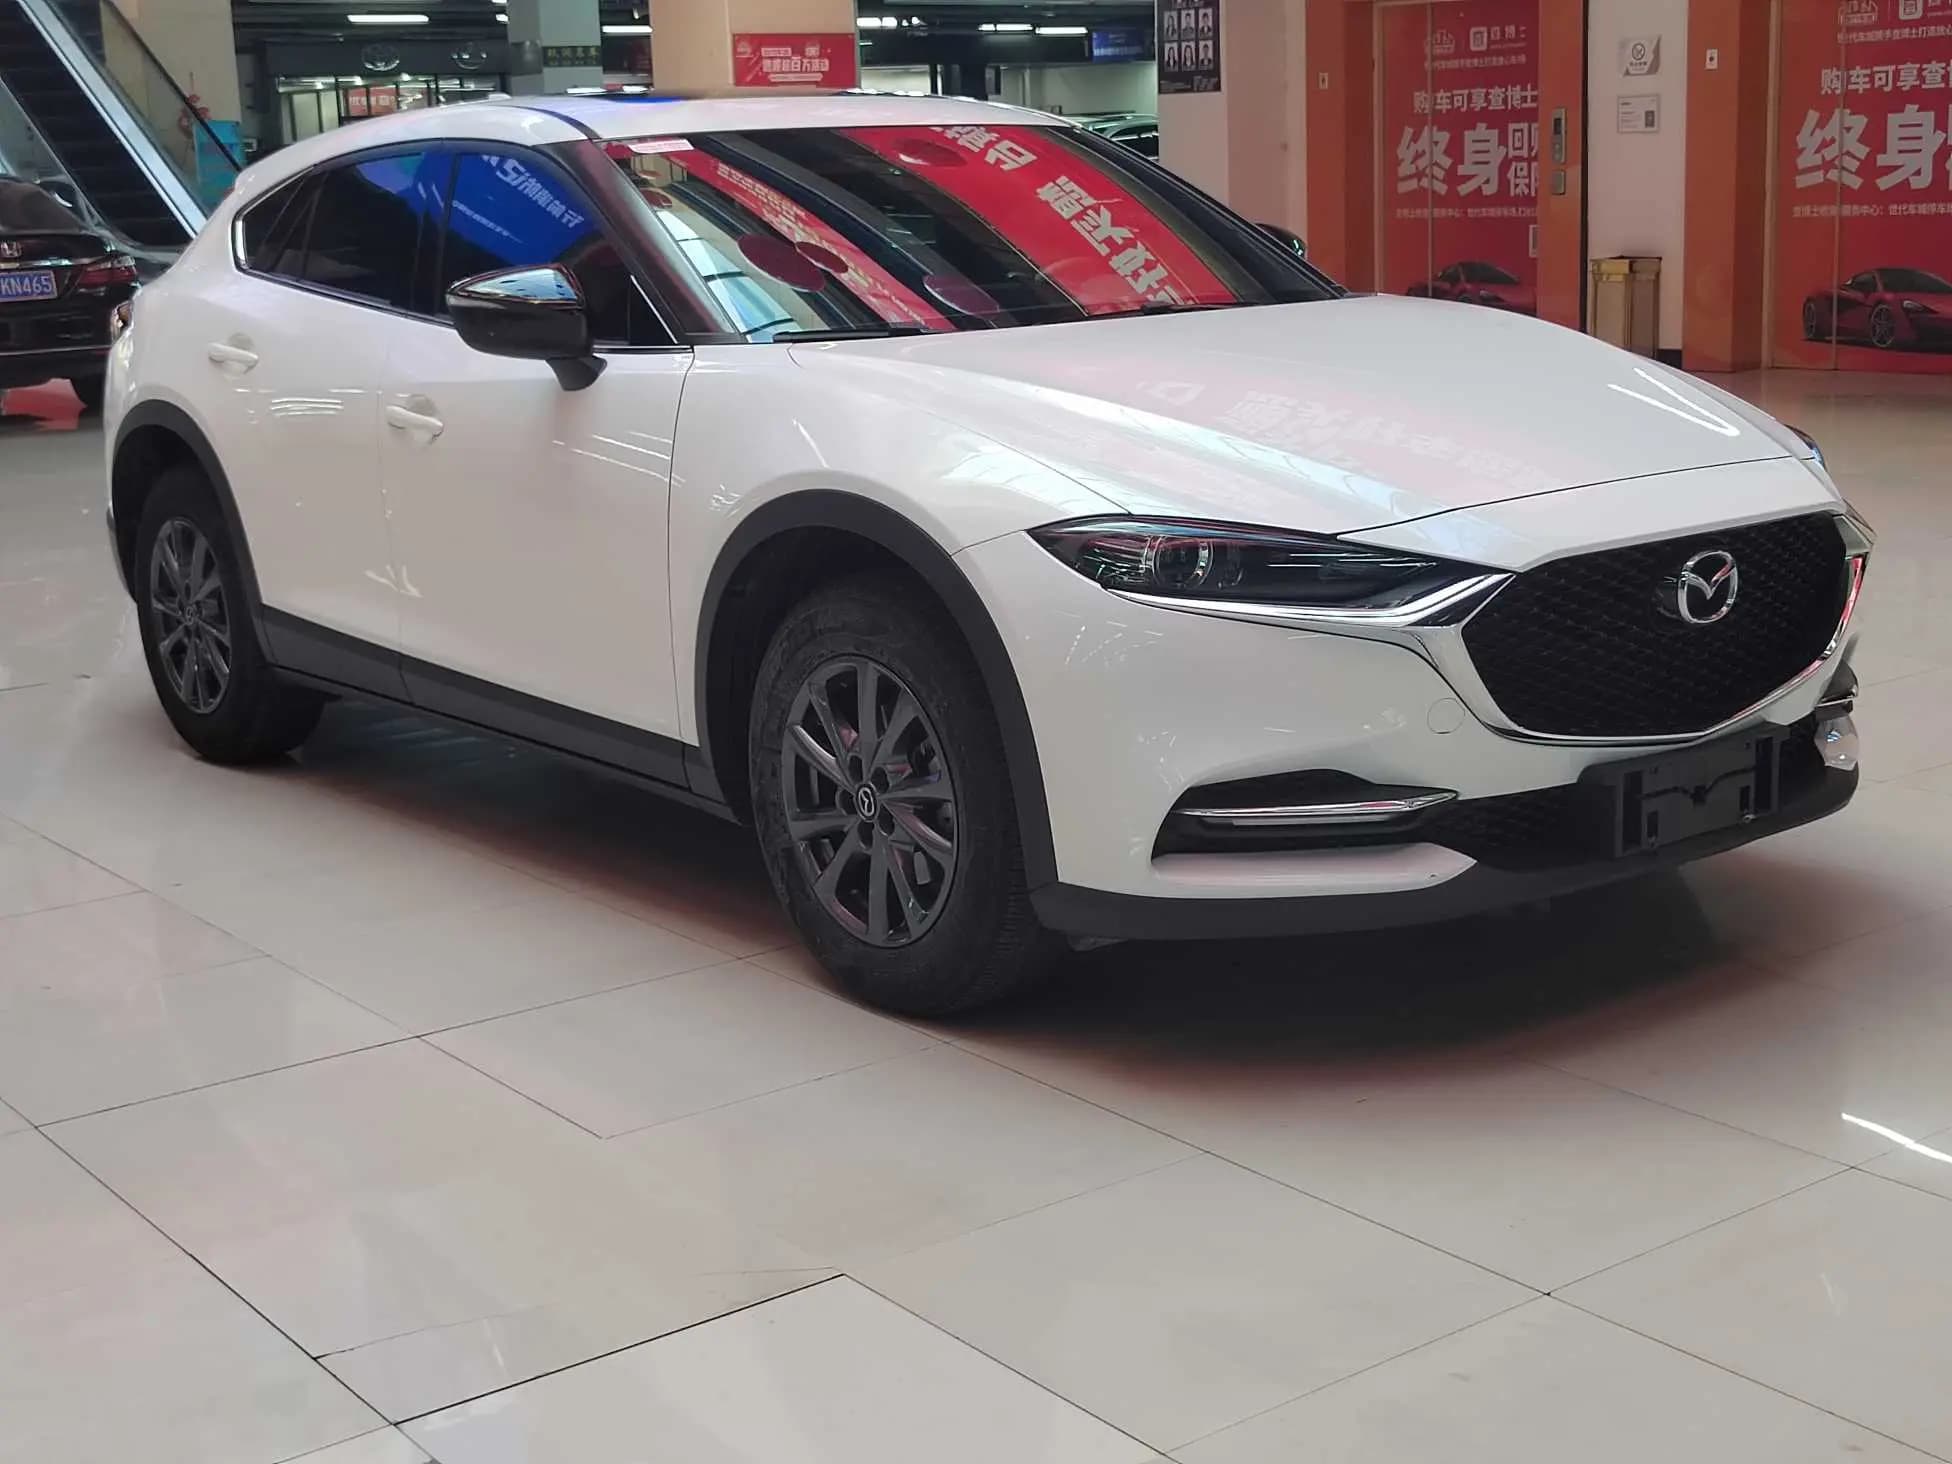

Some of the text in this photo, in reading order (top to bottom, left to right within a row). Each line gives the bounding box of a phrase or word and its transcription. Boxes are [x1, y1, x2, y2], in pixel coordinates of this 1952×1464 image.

[1820, 60, 1952, 95] 购车可享查
[1413, 84, 1538, 114] 购车可享查博士
[1396, 122, 1507, 197] 终身
[1795, 104, 1946, 191] 终身
[0, 275, 52, 295] KN465
